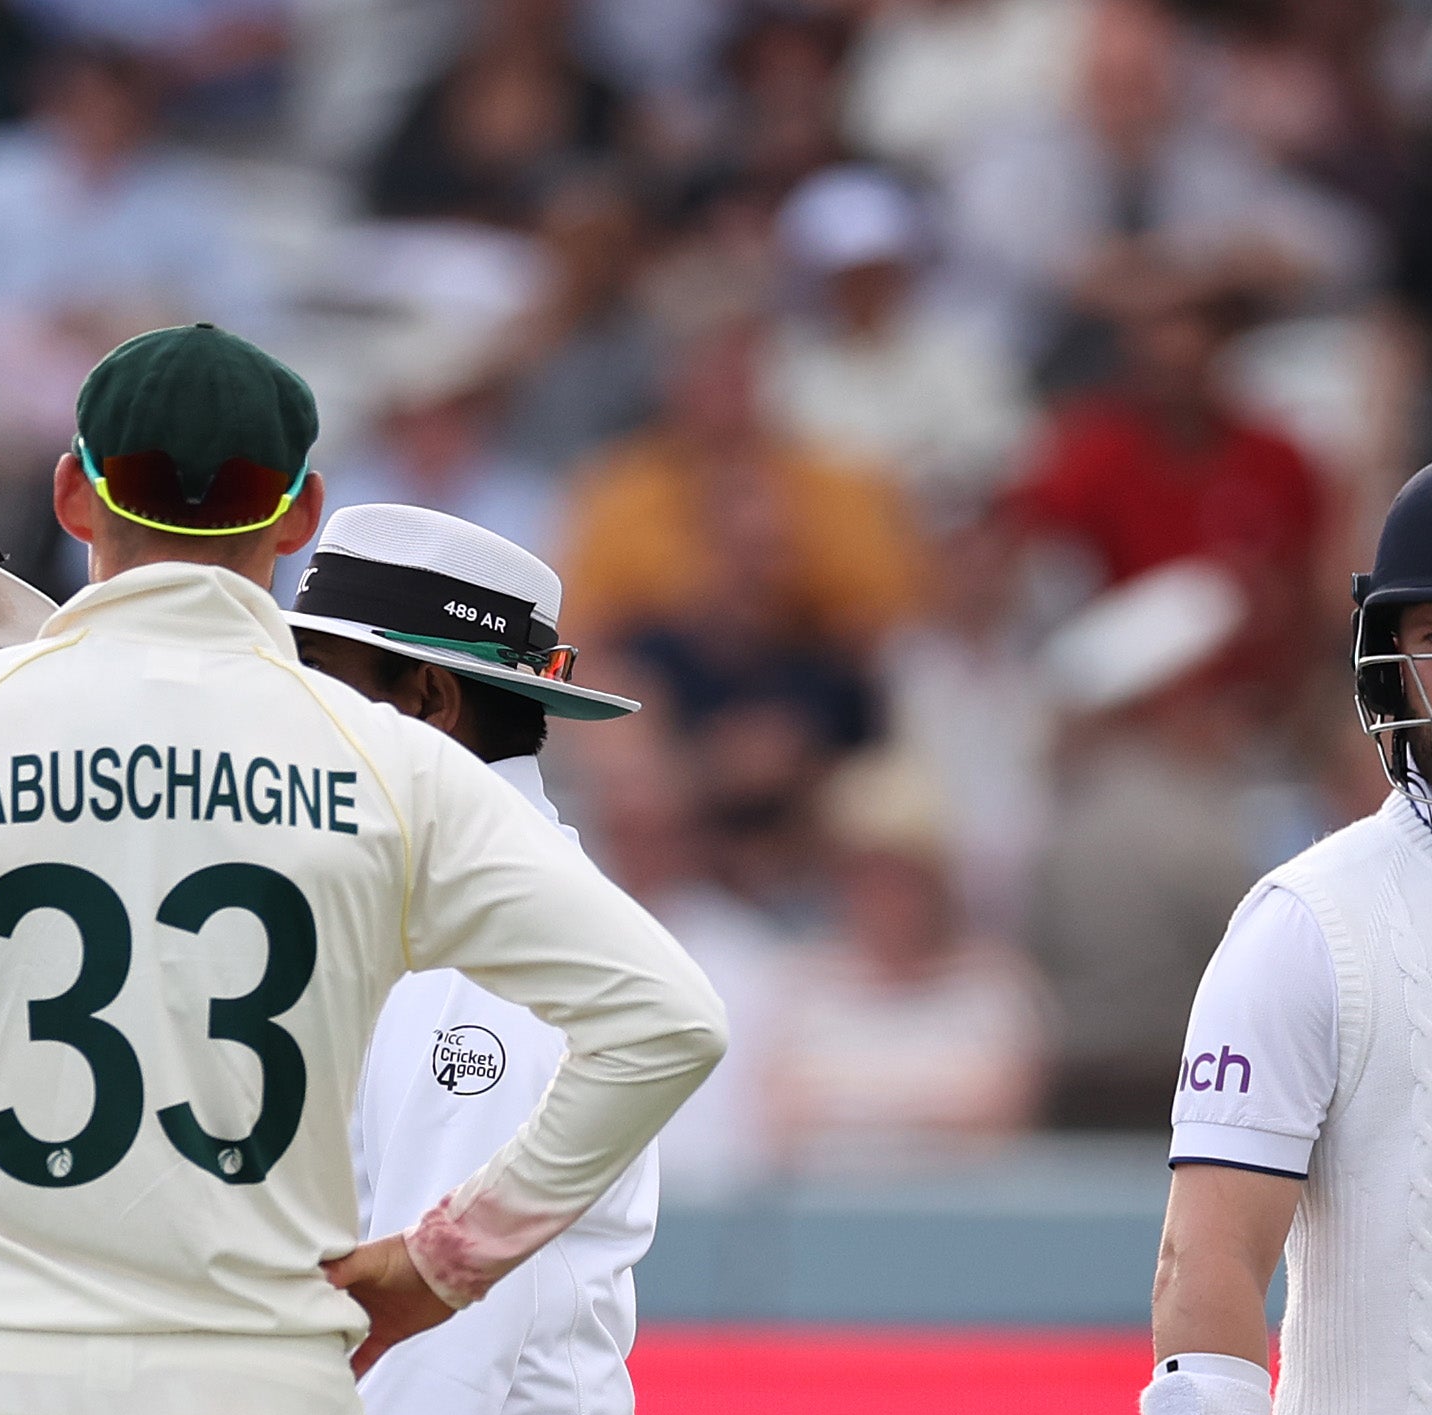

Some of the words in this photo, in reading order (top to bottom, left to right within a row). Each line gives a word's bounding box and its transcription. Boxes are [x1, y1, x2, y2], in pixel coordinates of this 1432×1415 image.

[443, 600, 478, 622] 489
[480, 612, 508, 634] AR
[444, 1033, 465, 1046] ICC
[441, 1047, 494, 1066] Cricket
[436, 1063, 458, 1091] 4
[457, 1064, 497, 1079] good
